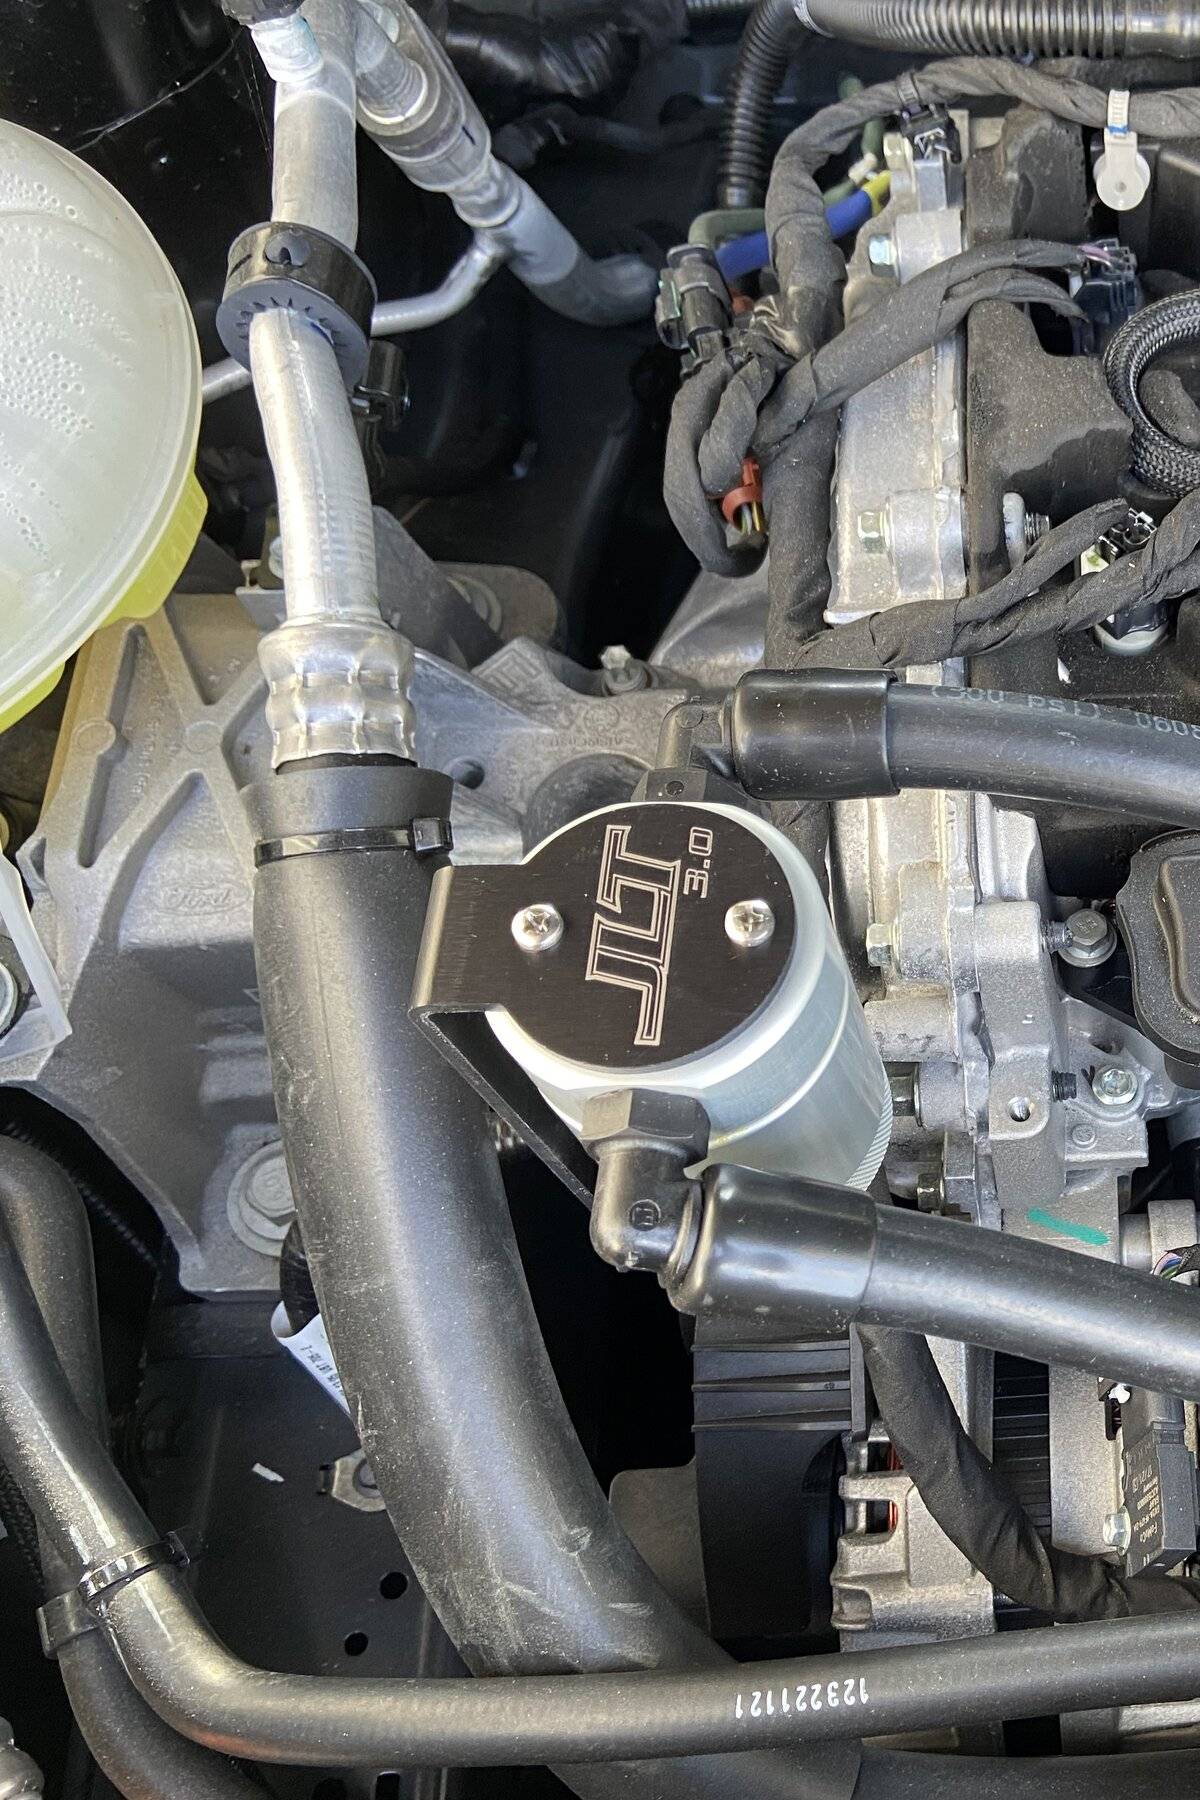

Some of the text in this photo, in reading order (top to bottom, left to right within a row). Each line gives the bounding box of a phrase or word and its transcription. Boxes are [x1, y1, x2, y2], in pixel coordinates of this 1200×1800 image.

[682, 827, 713, 898] 3.0
[584, 825, 682, 1046] JLT
[735, 1677, 869, 1719] 123221121
